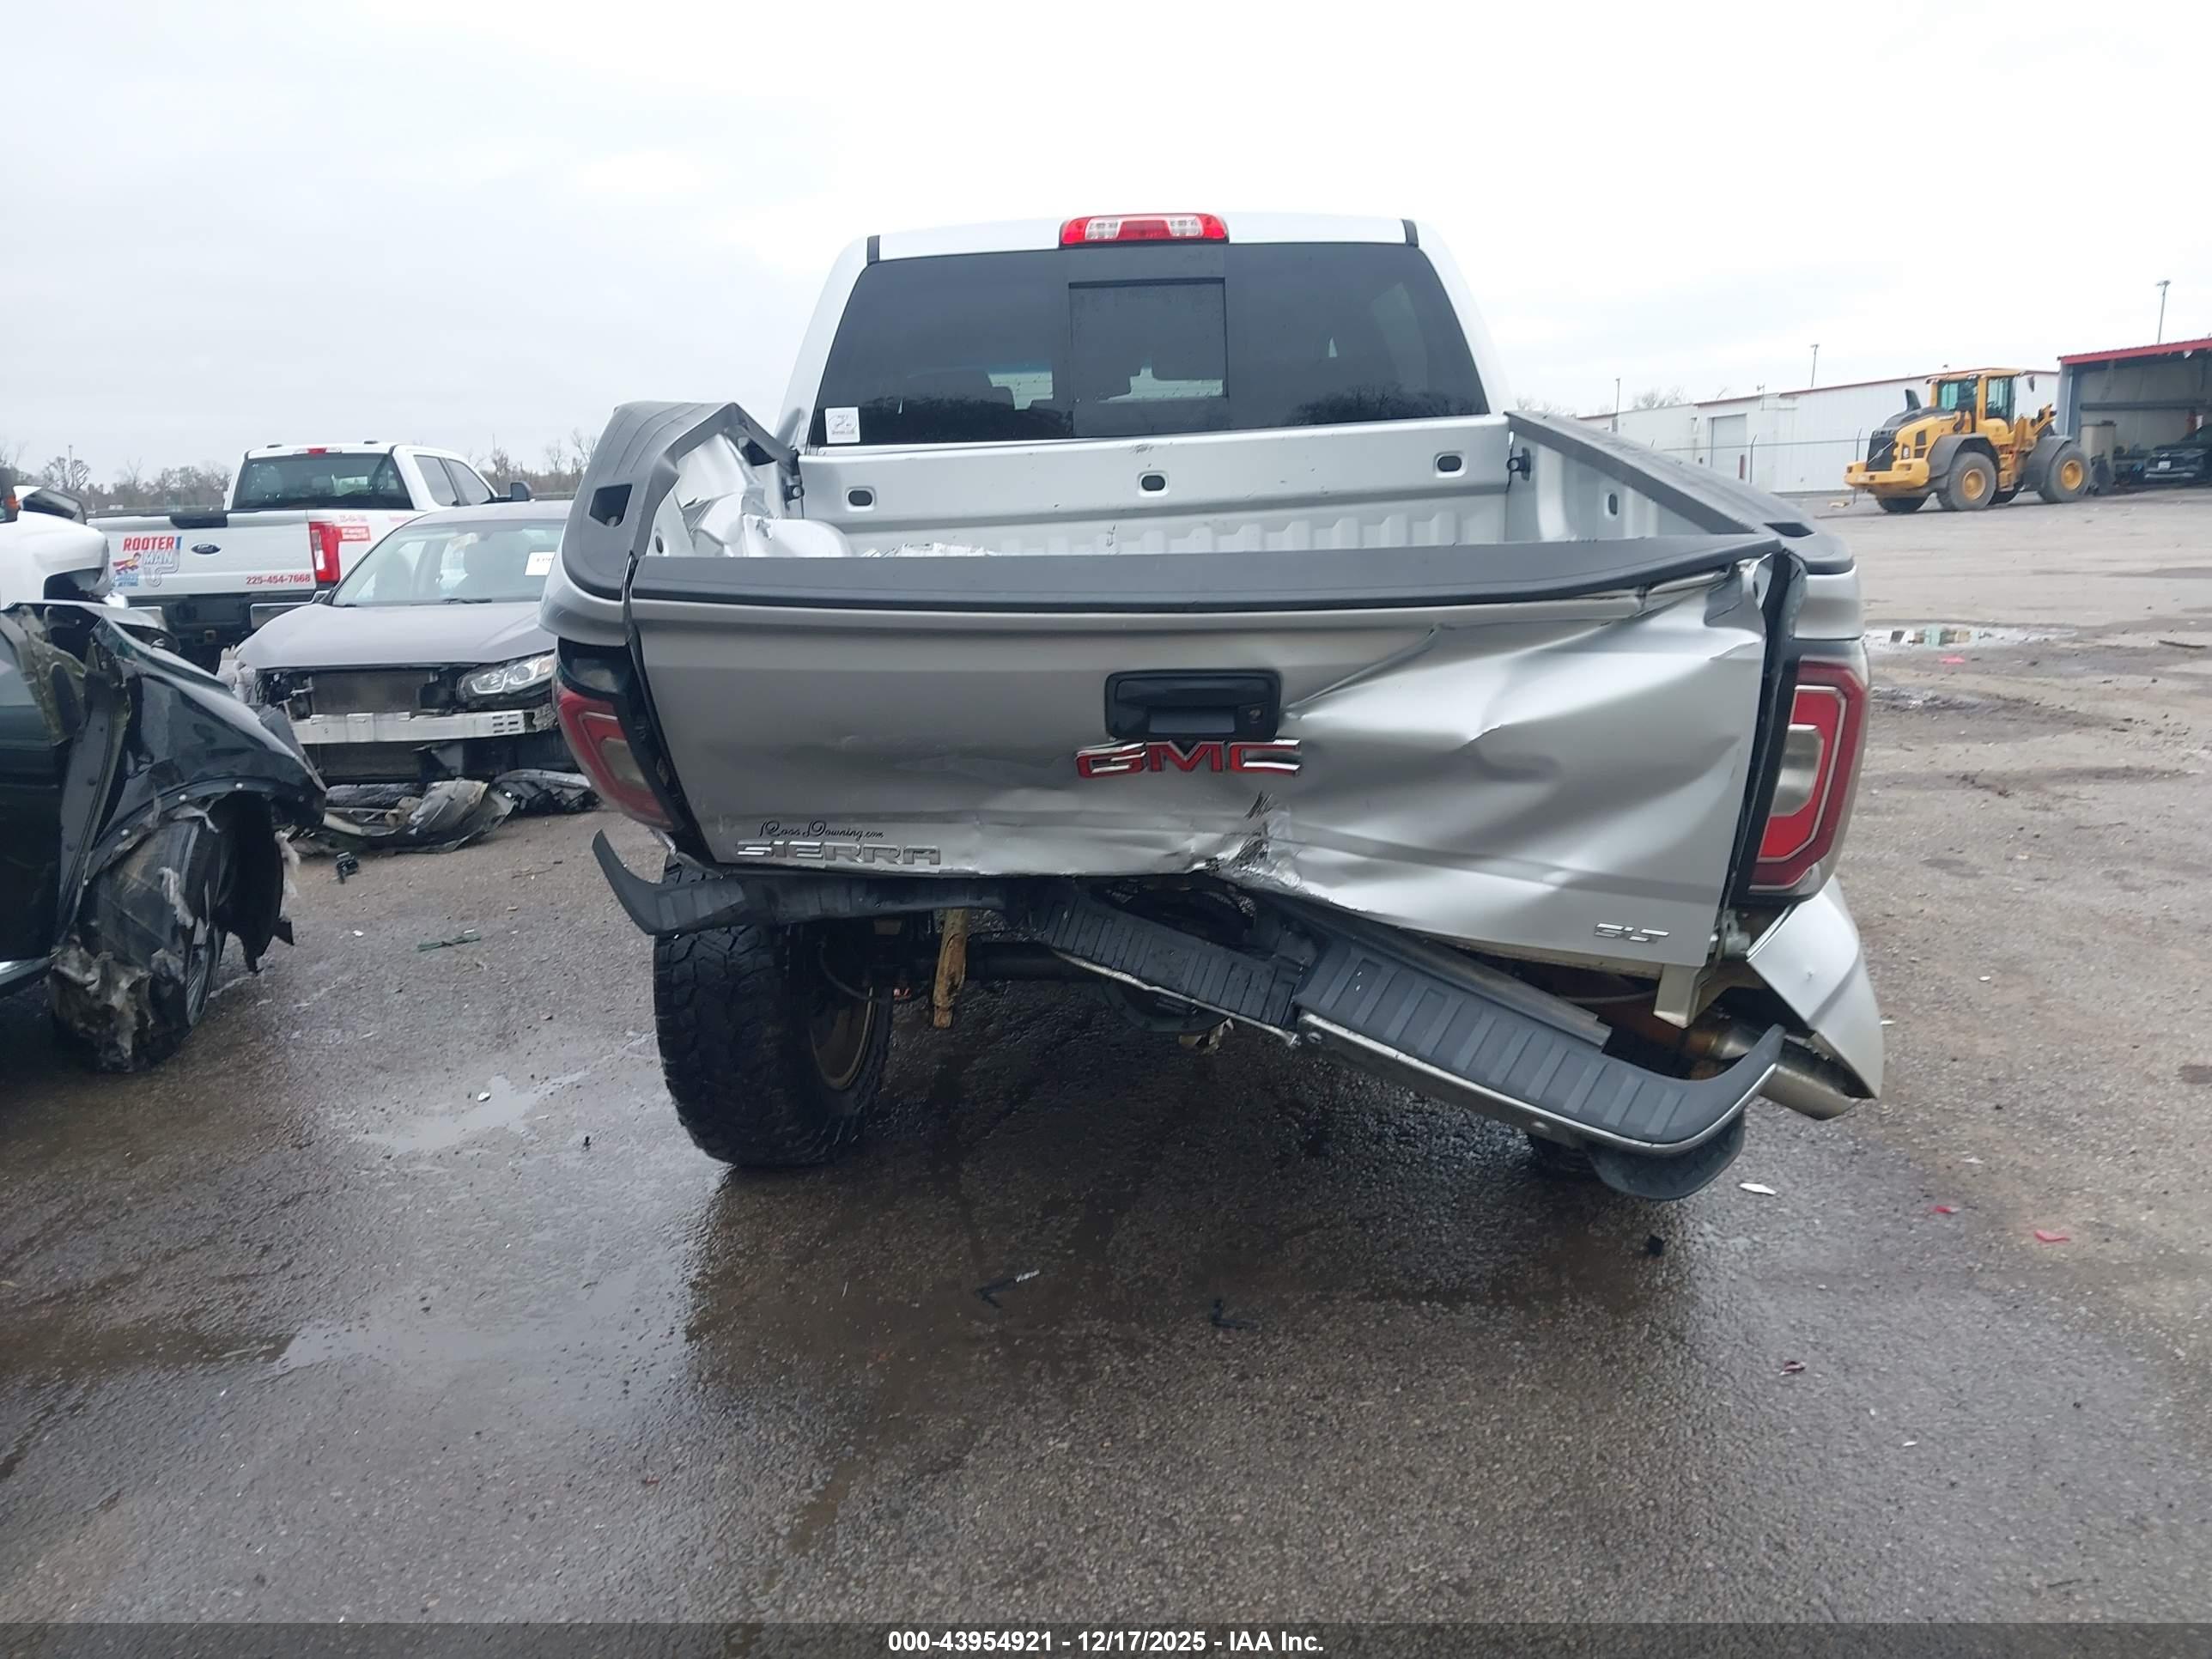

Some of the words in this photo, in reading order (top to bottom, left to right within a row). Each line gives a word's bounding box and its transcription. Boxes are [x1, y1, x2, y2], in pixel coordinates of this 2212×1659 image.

[123, 536, 175, 551] ROOTER
[143, 550, 173, 565] MAN
[246, 574, 312, 586] 225-454-7668
[1075, 739, 1302, 778] GMC
[736, 841, 942, 866] SIERRA
[1595, 922, 1670, 943] SLT
